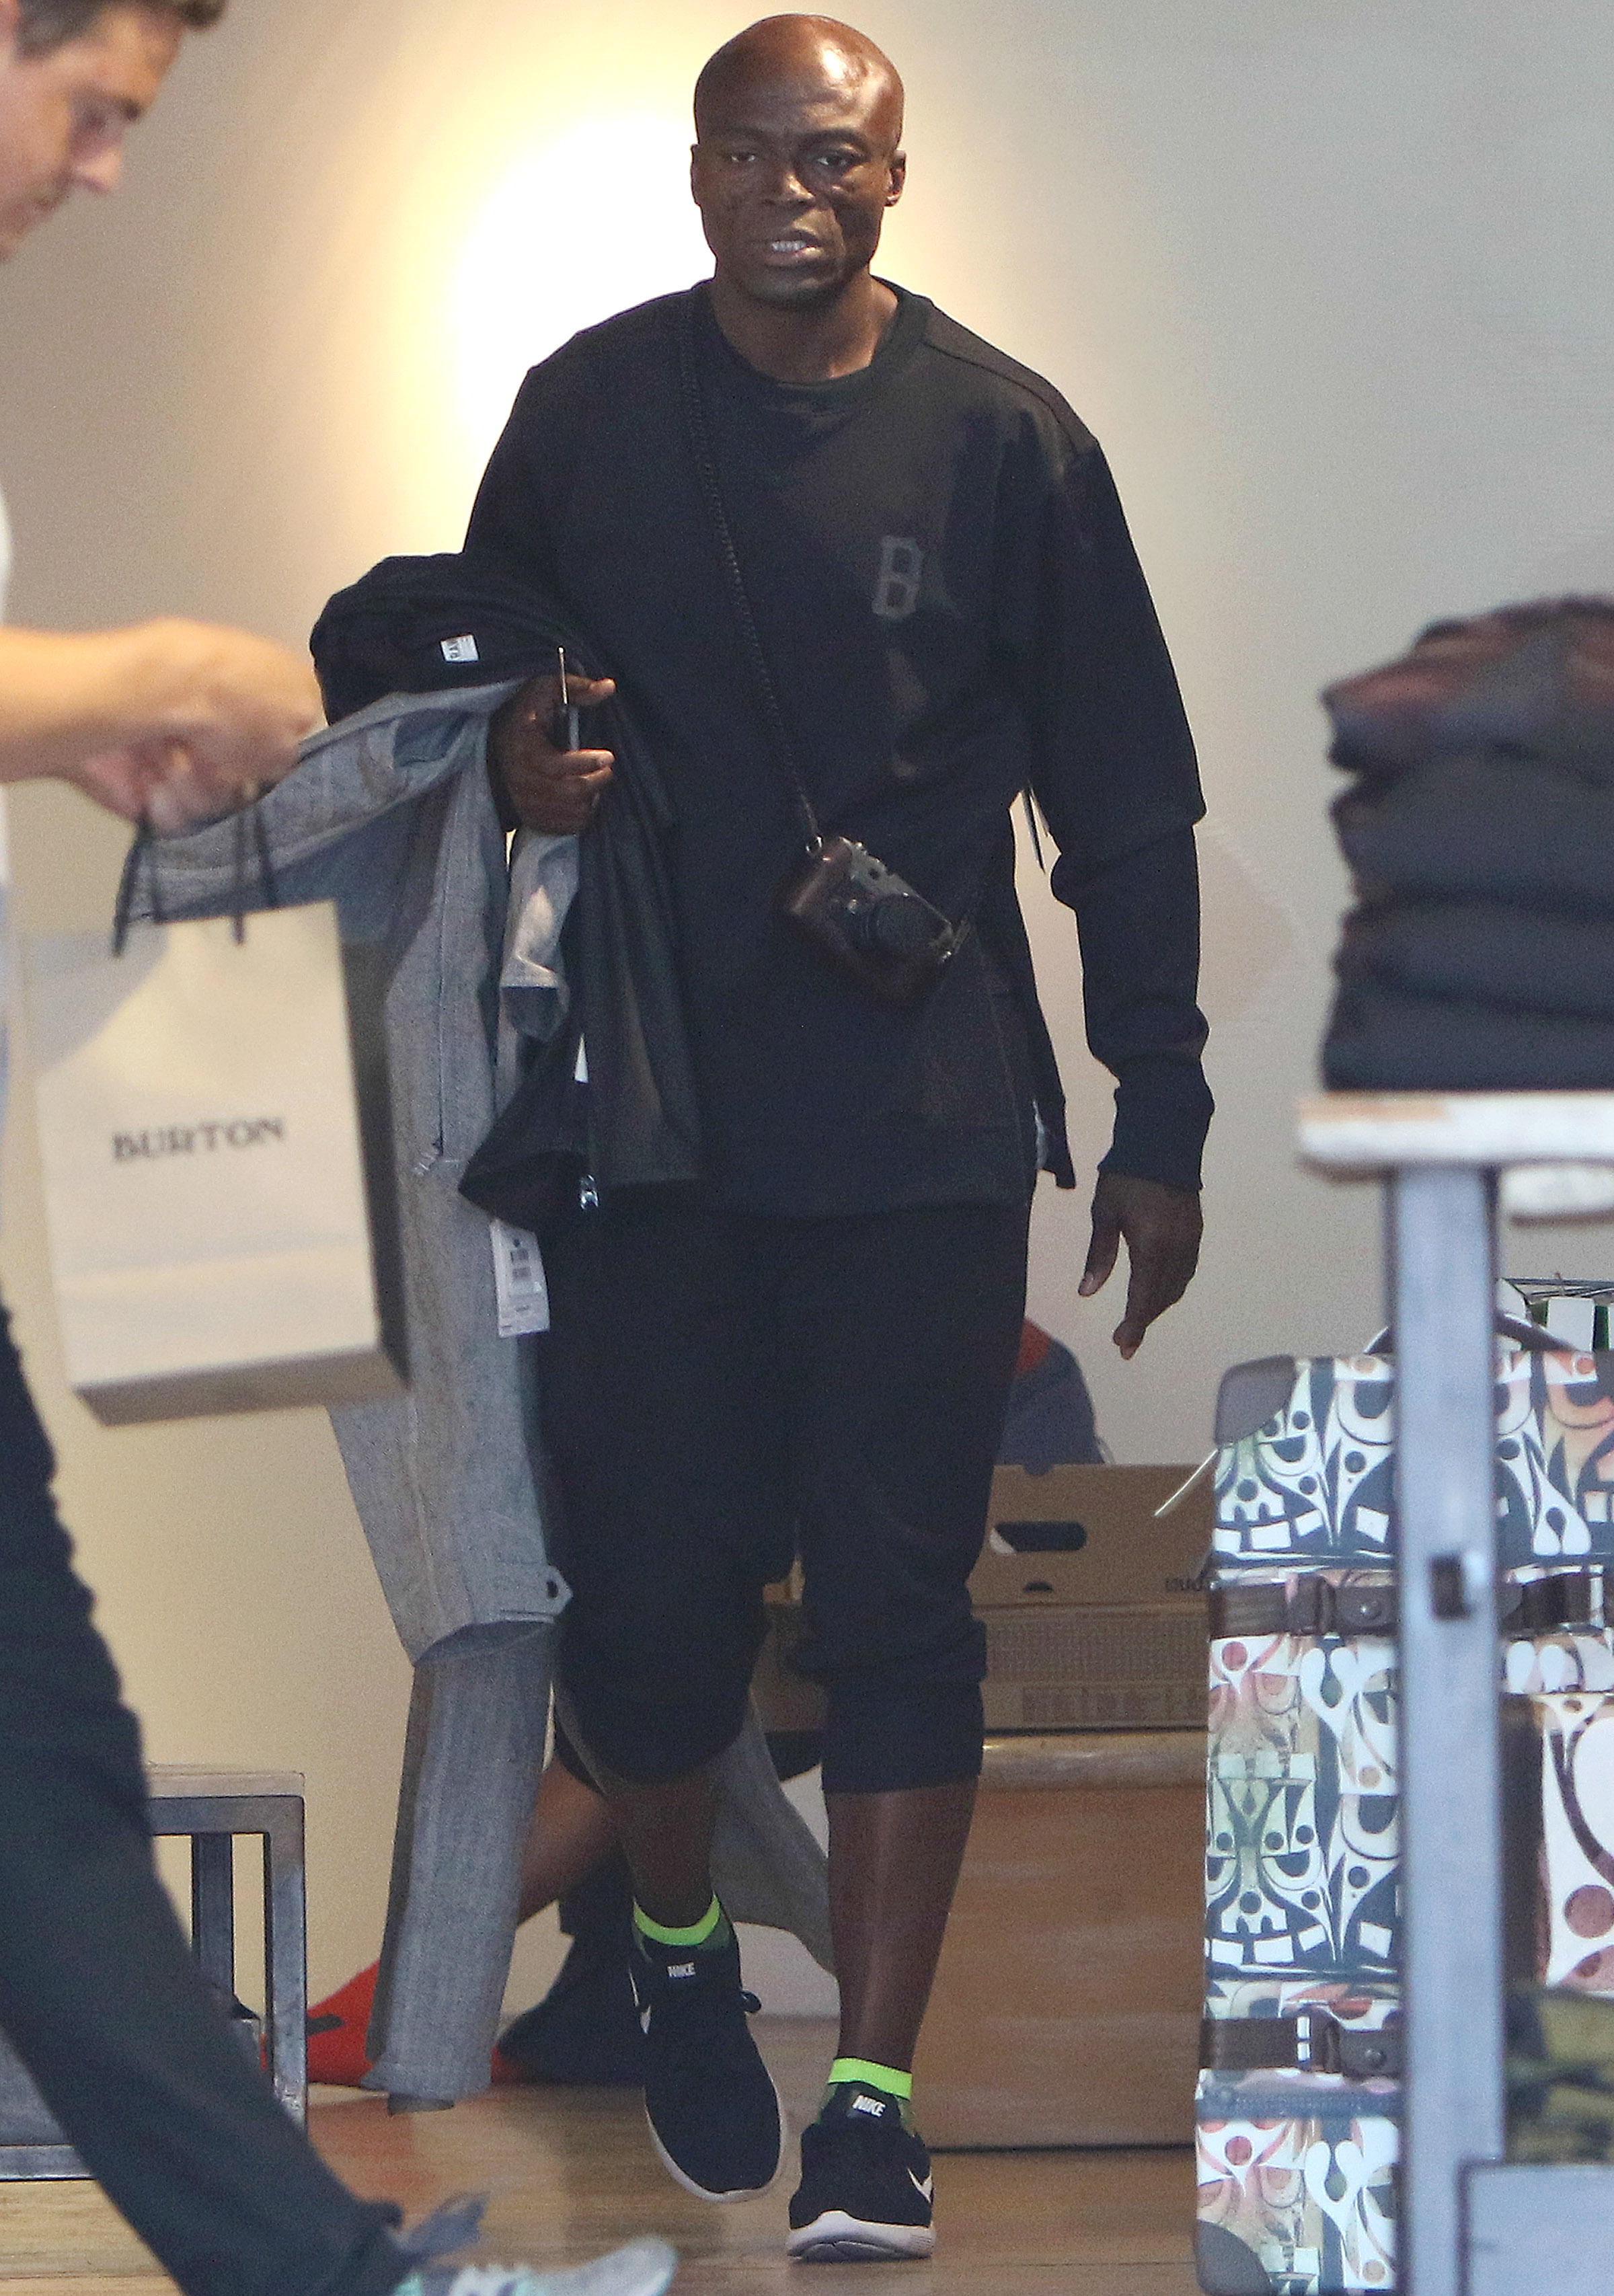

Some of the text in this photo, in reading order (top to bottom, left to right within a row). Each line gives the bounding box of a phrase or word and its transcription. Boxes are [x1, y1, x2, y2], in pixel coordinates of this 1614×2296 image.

[872, 536, 922, 617] B
[112, 1118, 284, 1161] BURTON
[667, 1962, 696, 1977] NIKE
[852, 2094, 886, 2116] NIKE
